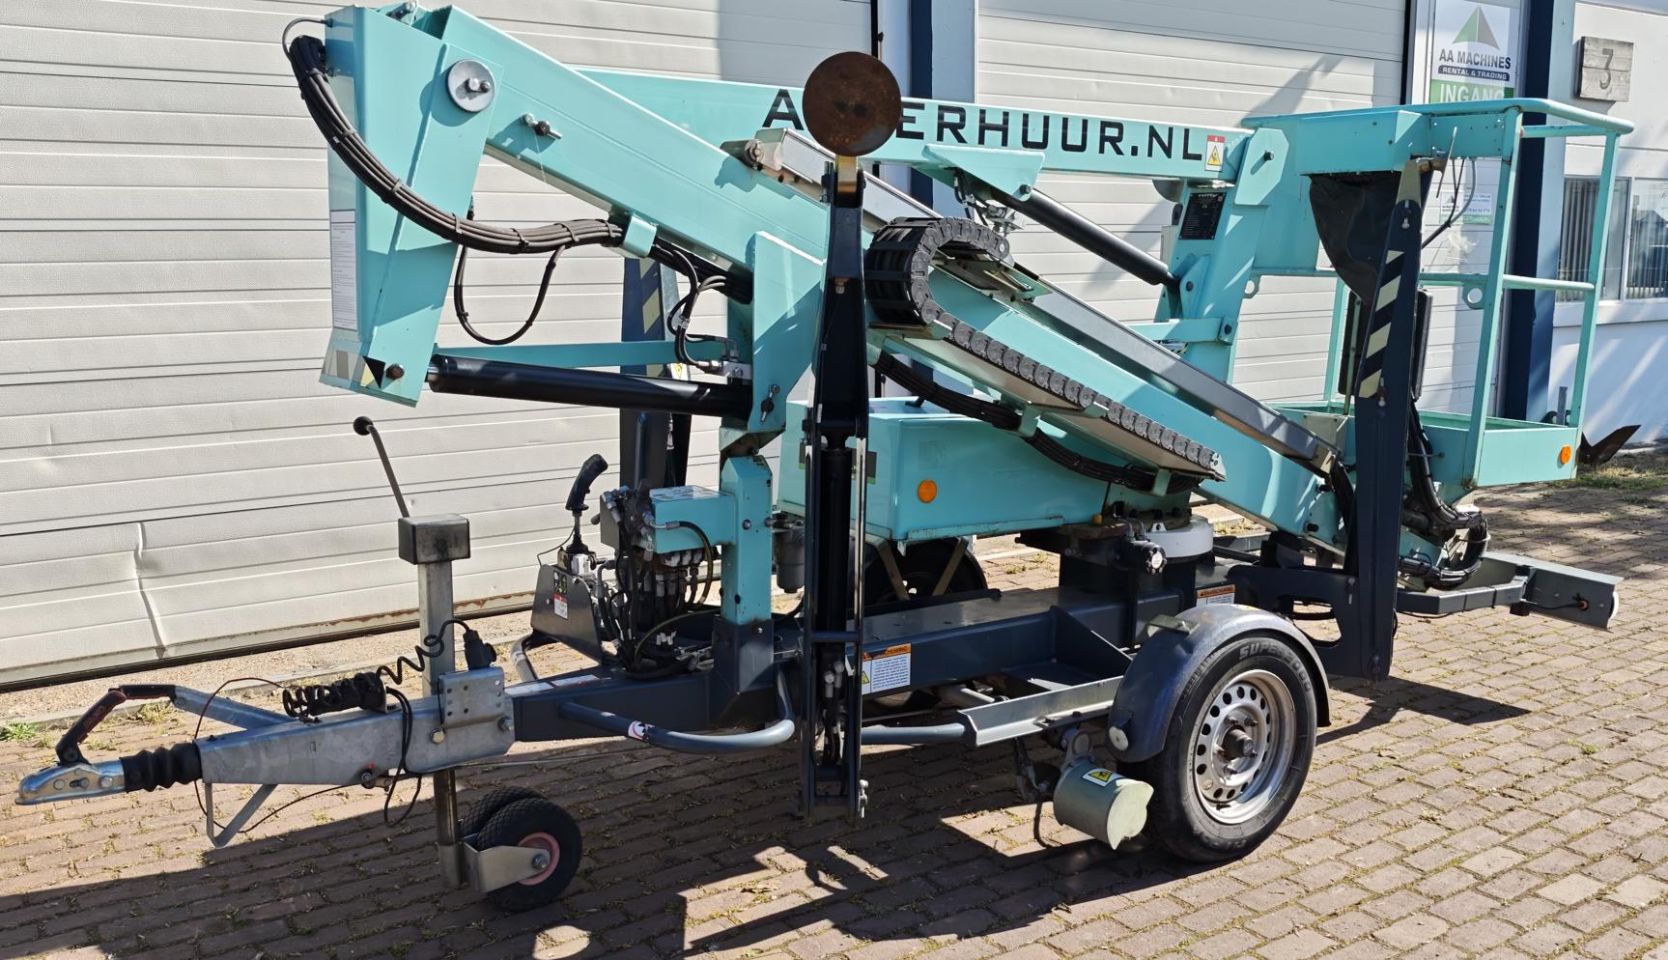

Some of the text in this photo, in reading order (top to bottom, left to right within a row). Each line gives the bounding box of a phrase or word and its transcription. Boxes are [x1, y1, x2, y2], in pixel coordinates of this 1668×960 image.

[1439, 48, 1512, 70] AA MACHINES
[1442, 67, 1470, 77] RENTAL
[1477, 70, 1508, 81] TRADING
[1599, 48, 1613, 90] 3
[762, 88, 1203, 161] AERHUUR.NL
